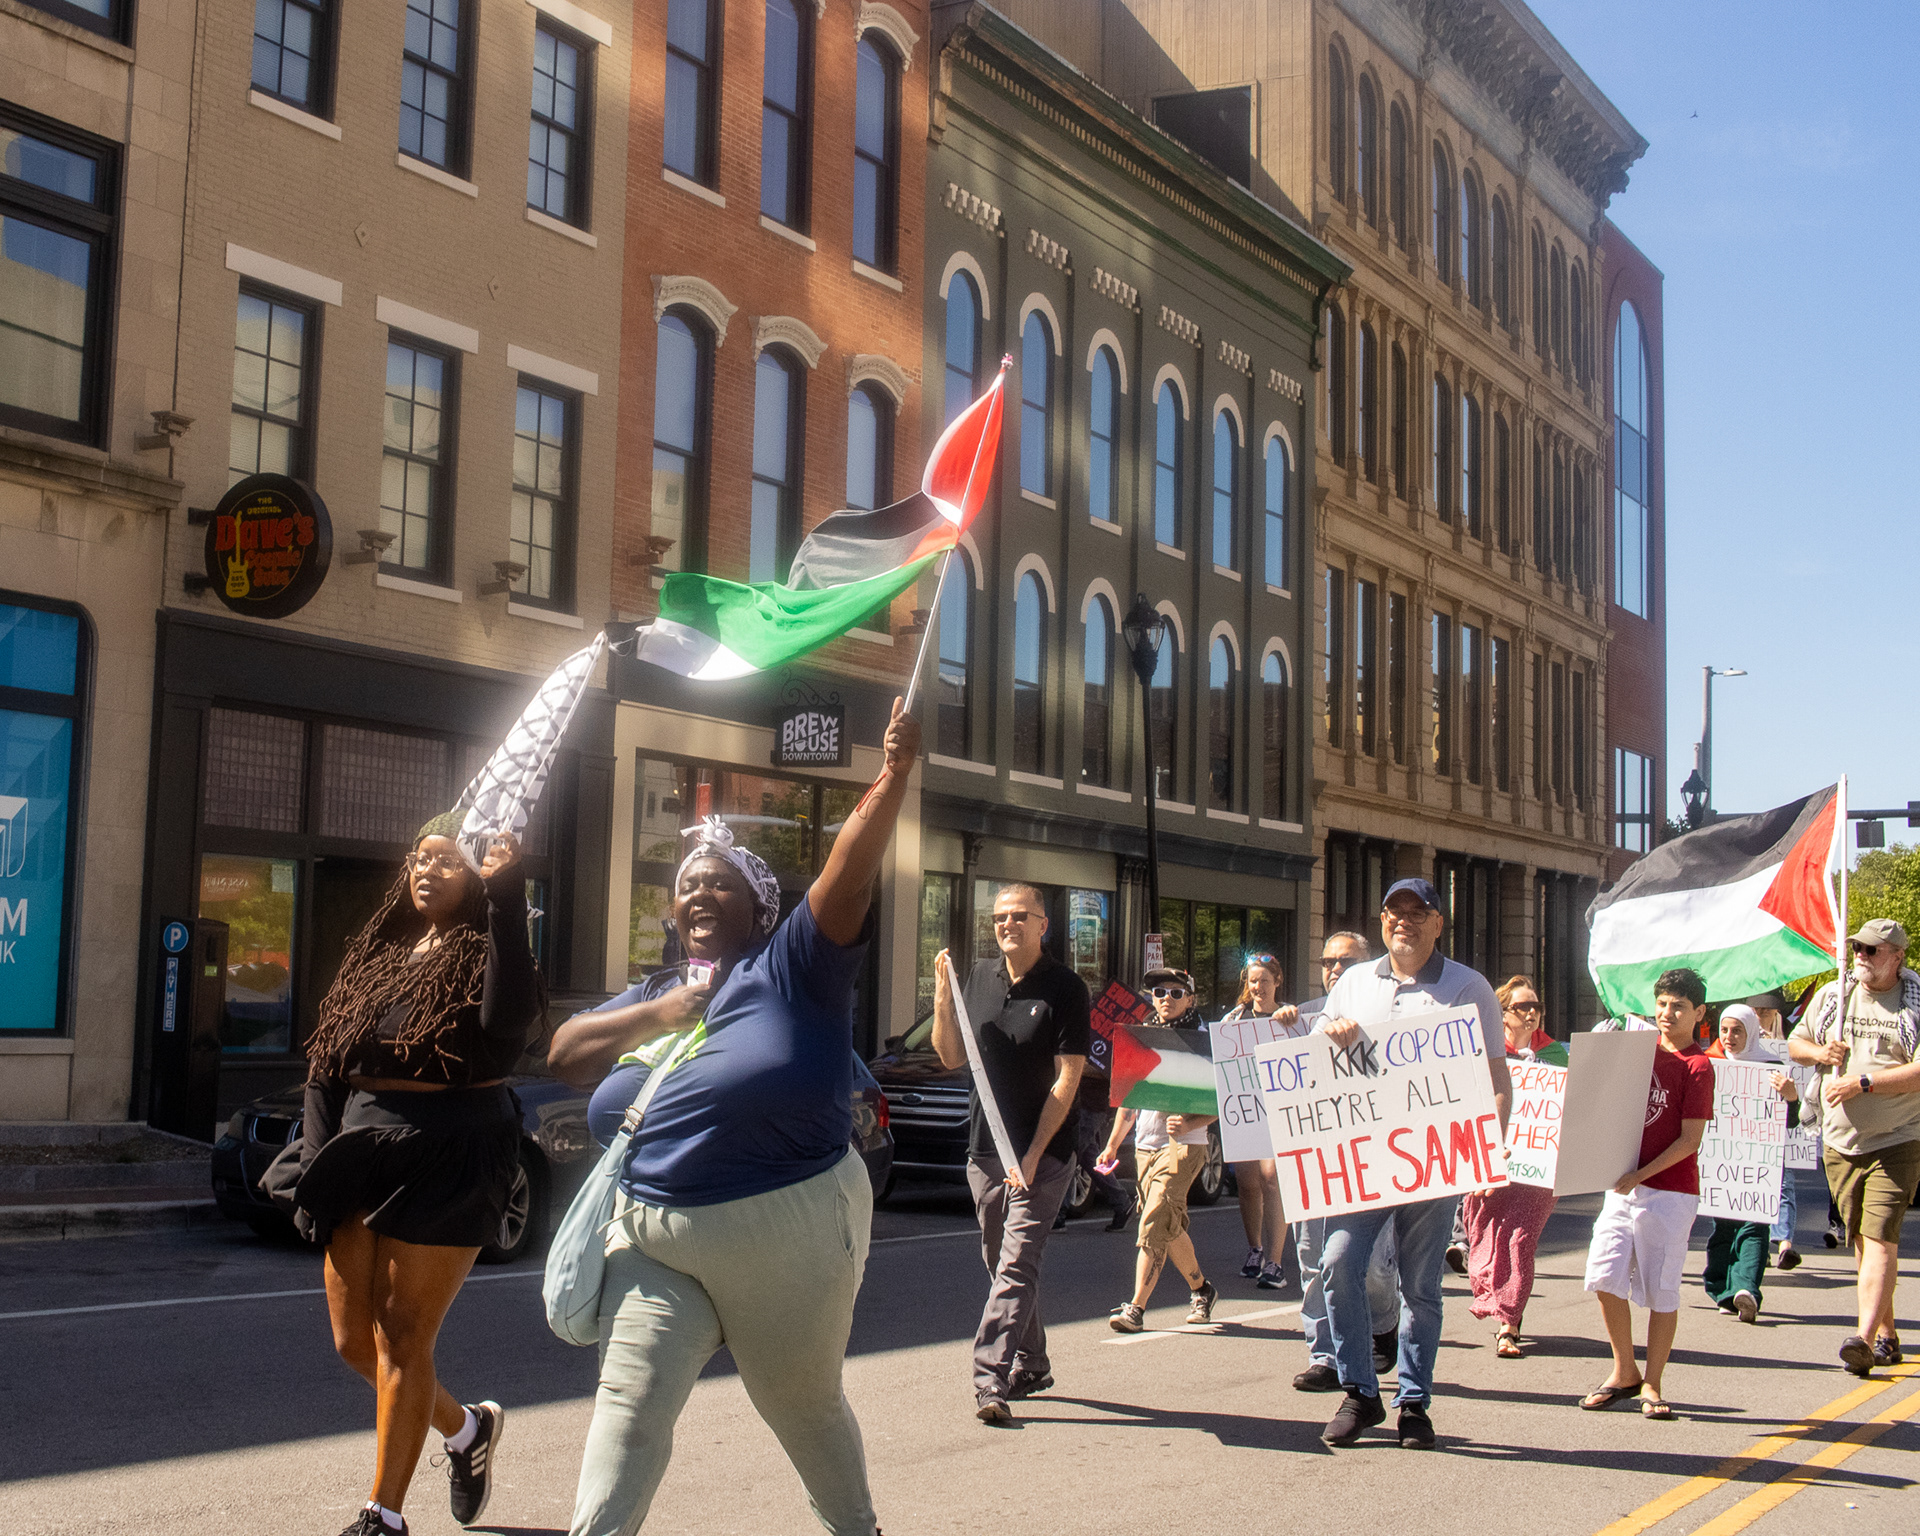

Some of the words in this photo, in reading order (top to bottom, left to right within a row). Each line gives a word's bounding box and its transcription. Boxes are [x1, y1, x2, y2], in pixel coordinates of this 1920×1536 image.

[215, 512, 314, 551] Dave's
[783, 712, 839, 745] BREW
[782, 752, 838, 761] DOWNTOWN
[168, 961, 176, 989] PAY
[165, 991, 175, 1029] HERE
[1106, 981, 1136, 1010] END
[1842, 1015, 1899, 1029] ECOLONIZ
[1844, 1027, 1891, 1041] PALESTINE
[1259, 1052, 1317, 1093] IOF,
[1329, 1039, 1388, 1080] KKK,
[1386, 1027, 1430, 1067] COP
[1433, 1017, 1483, 1058] CITY,
[1713, 1064, 1764, 1098] USTICE
[1278, 1089, 1383, 1138] THEY'RE
[1407, 1072, 1461, 1112] ALL
[1713, 1094, 1787, 1121] ESTINE
[1724, 1115, 1785, 1142] THREAT
[1277, 1135, 1381, 1211] THE
[1387, 1113, 1507, 1193] SAME
[1706, 1138, 1785, 1168] JUSTICE
[1717, 1163, 1771, 1188] OVER
[1726, 1190, 1779, 1218] WORLD
